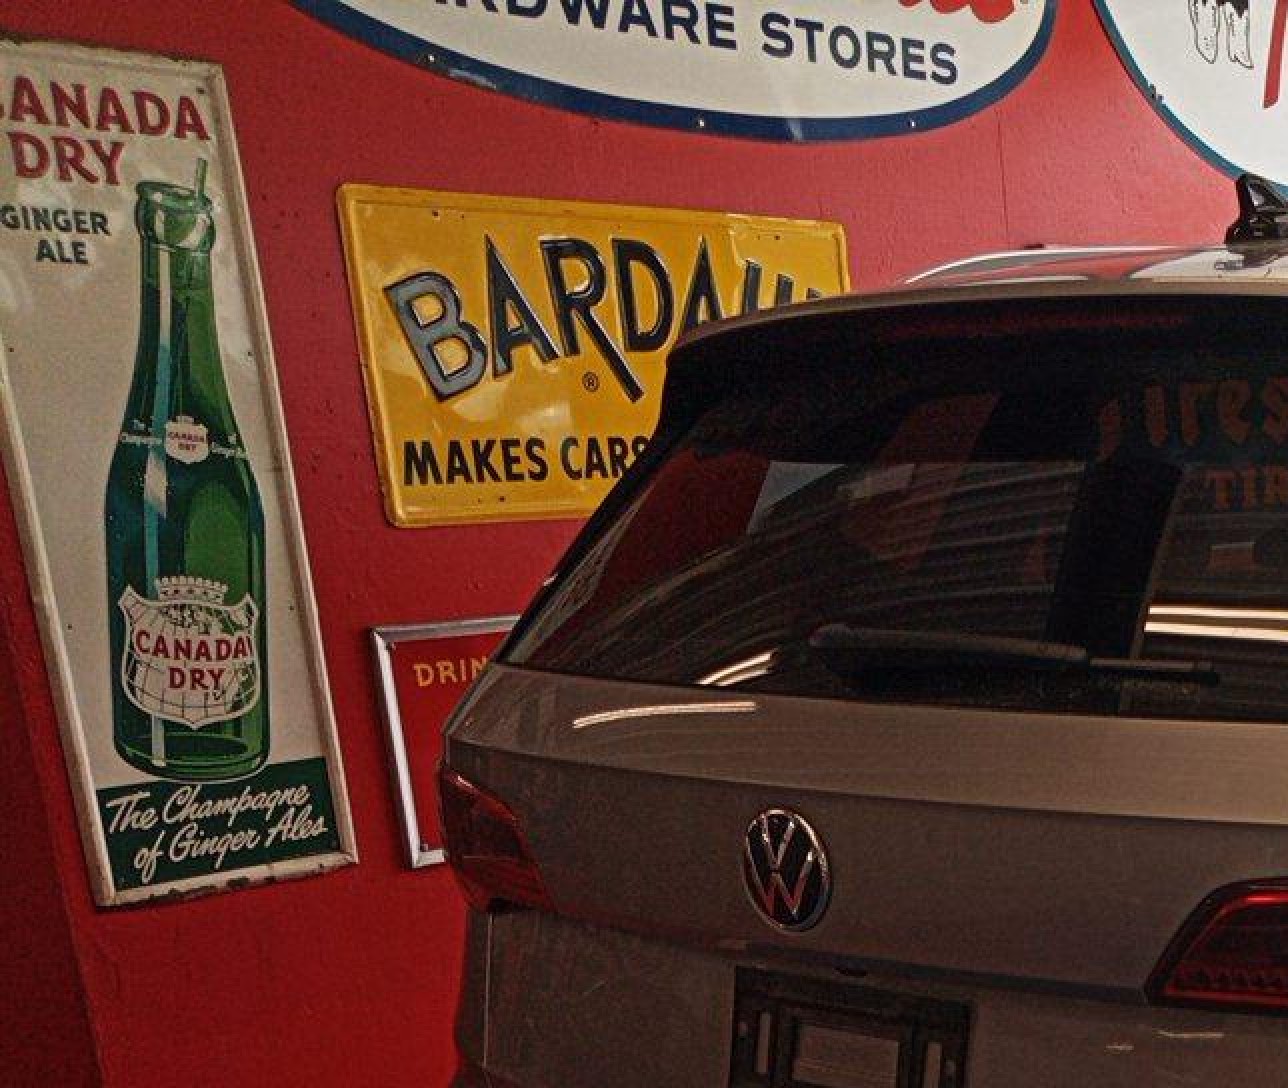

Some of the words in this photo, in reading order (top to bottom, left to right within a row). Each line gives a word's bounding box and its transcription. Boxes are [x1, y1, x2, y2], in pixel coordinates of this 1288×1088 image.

[434, 0, 737, 50] WARE
[759, 11, 958, 85] STORES
[0, 75, 211, 140] ANADA
[6, 131, 125, 186] DRY
[0, 203, 112, 237] GINGER
[35, 239, 89, 265] ALE
[383, 232, 822, 403] BARDA
[402, 436, 549, 486] MAKES
[135, 629, 252, 663] CANADA
[168, 667, 226, 691] DRY
[105, 791, 159, 835] The
[161, 783, 311, 828] Champagne
[133, 829, 167, 885] of
[169, 822, 261, 869] Ginger
[264, 803, 329, 848] Ales
